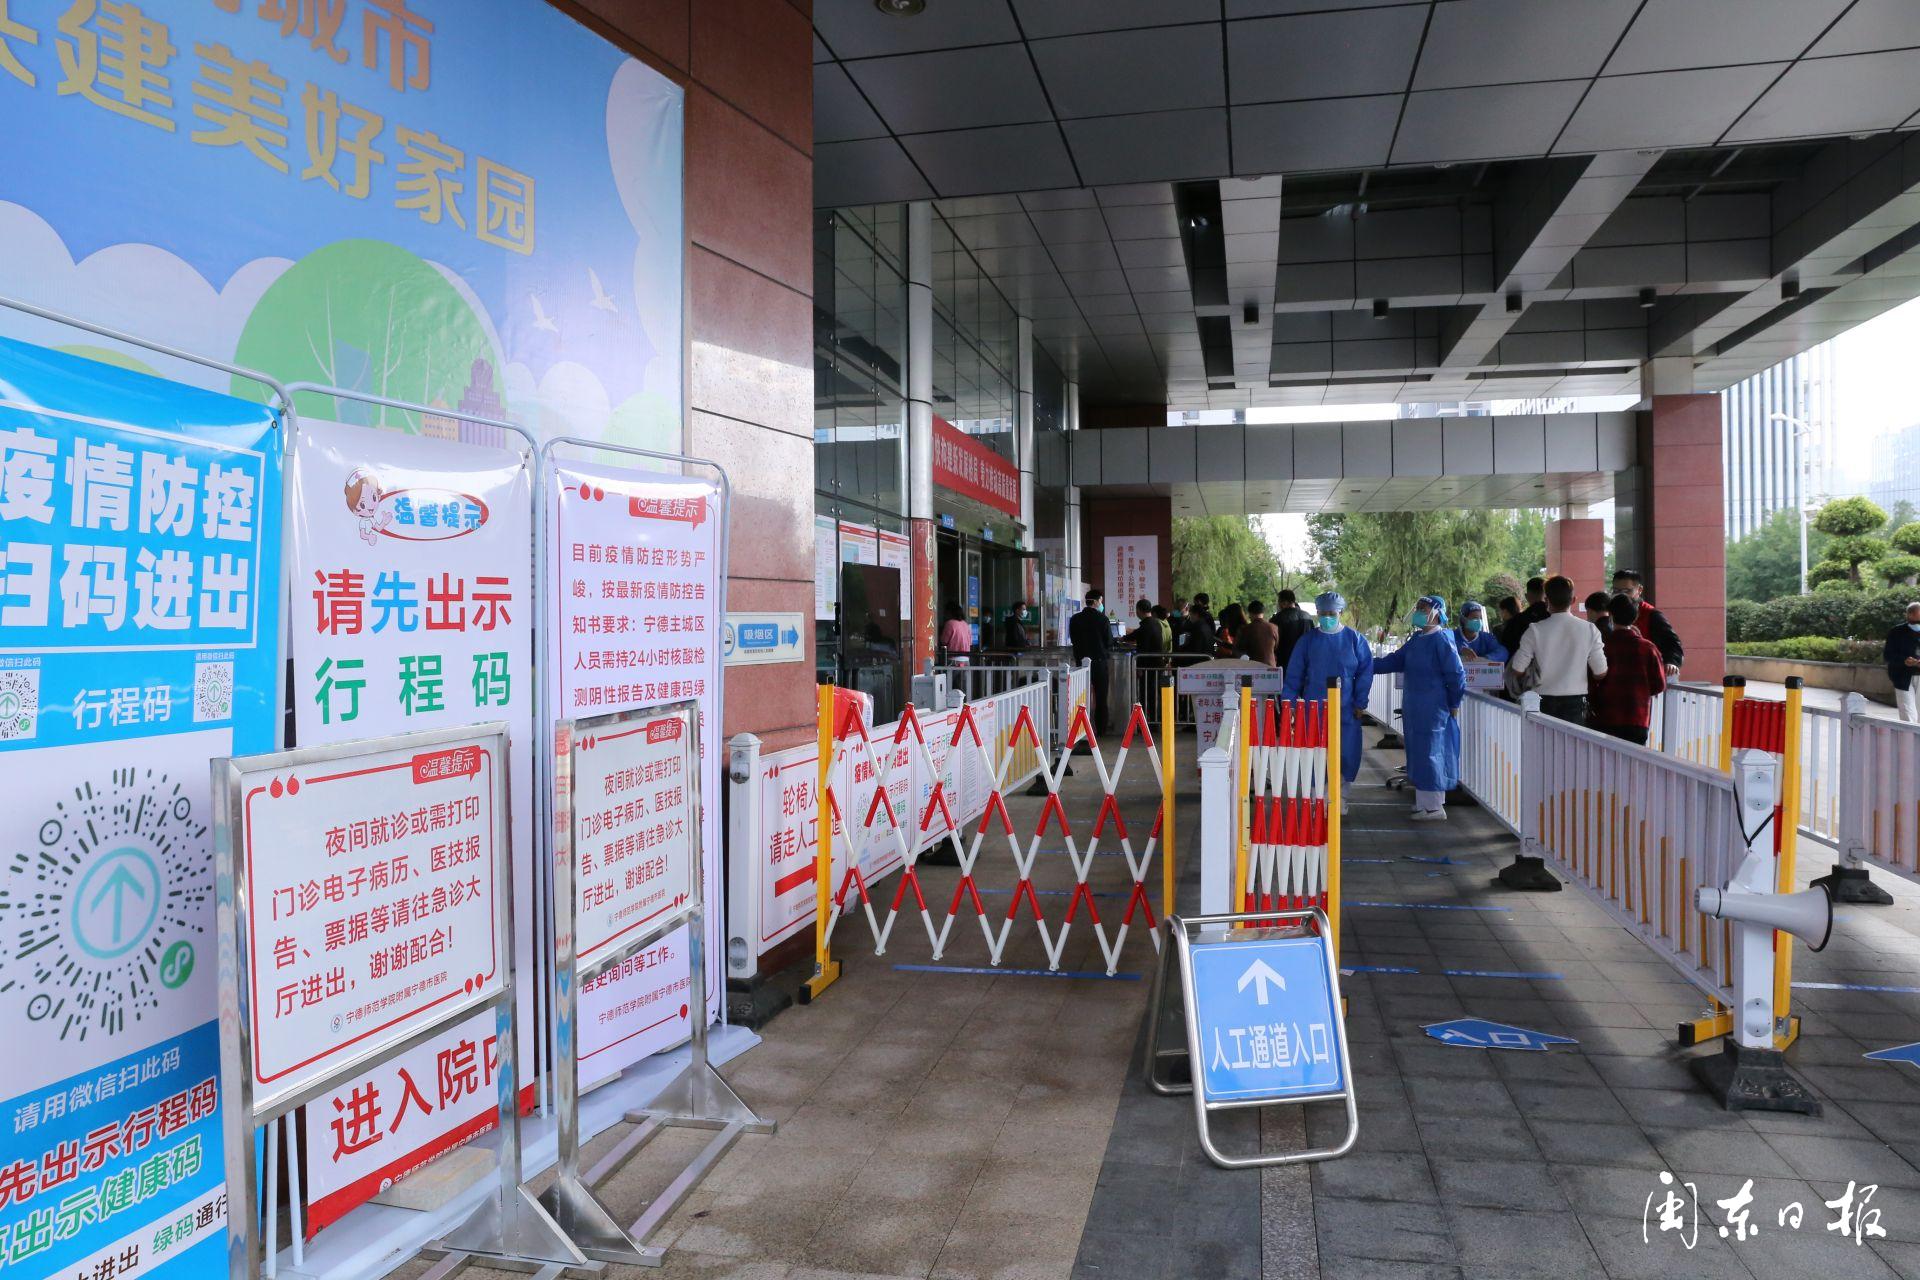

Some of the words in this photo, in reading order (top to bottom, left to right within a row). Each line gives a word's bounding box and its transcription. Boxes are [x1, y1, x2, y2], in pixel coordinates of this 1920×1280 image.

[0, 428, 254, 542] 疫情防控
[638, 498, 699, 518] 温馨提示
[395, 496, 481, 529] 温馨提示
[573, 543, 705, 567] 目前疫情防控形势严
[313, 569, 512, 636] 请先出示
[573, 579, 705, 600] 峻，按最新疫情防控告
[573, 616, 705, 634] 知书要求：宁德主城区
[744, 628, 774, 640] 吸烟区
[574, 647, 705, 671] 人员需持24小时核酸检
[72, 685, 172, 730] 行程码
[314, 652, 512, 725] 行程码
[574, 680, 705, 707] 测阴性报告及健康码绿
[650, 720, 679, 740] 温馨提示
[421, 750, 474, 778] 温馨提示
[604, 756, 681, 796] 夜间就诊或需打印
[325, 795, 480, 858] 夜间就诊或需打印
[581, 786, 682, 840] 门诊电子病历、医技报
[581, 817, 683, 877] 告、票据等请往急诊大
[272, 835, 480, 921] 门诊电子病历、医技报
[582, 854, 668, 912] 厅进出，谢谢配合！
[274, 875, 480, 970] 告、票据等请往急诊大
[275, 925, 453, 1018] 厅进出，谢谢配合！
[346, 971, 448, 1024] 宁德师范学院附属宁德市医院
[599, 977, 691, 1024] 宁德师范学院附属宁德市医院
[1211, 1022, 1330, 1072] 人工通道入口
[1440, 1029, 1531, 1046] 入口
[13, 1047, 181, 1134] 请用微信扫此码
